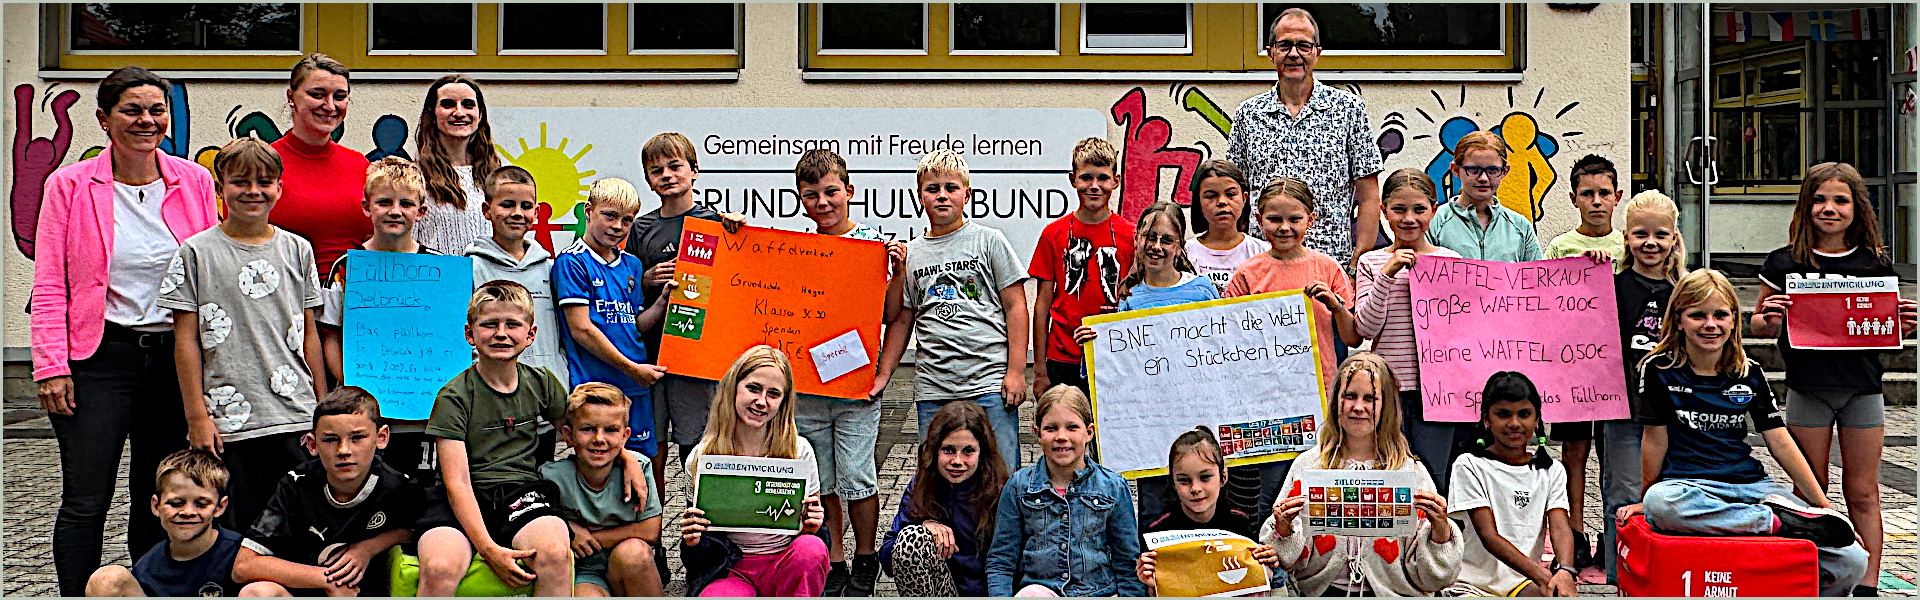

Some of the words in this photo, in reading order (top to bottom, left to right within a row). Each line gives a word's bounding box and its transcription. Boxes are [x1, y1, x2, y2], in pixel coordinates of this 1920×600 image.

[704, 134, 839, 156] Gemeinsam
[848, 133, 883, 155] mit
[889, 133, 965, 156] Freude
[972, 134, 1042, 156] lernen
[348, 254, 441, 282] Füllhorn
[944, 259, 978, 272] STARS
[1411, 259, 1597, 291] WAFFEL-VERKAUF
[1415, 294, 1472, 330] große
[1480, 295, 1551, 314] WAFFEL
[356, 321, 379, 337] Das
[1108, 324, 1156, 353] BNE
[1170, 315, 1227, 340] macht
[1242, 310, 1263, 331] die
[1269, 304, 1305, 327] Welt
[1144, 354, 1170, 376] ein
[1186, 345, 1269, 368] Stückchen
[1274, 336, 1312, 358] besser
[1420, 339, 1473, 364] kleine
[1478, 339, 1553, 363] WAFFEL
[1422, 381, 1455, 407] Wir
[1571, 385, 1621, 404] Füllhorn
[754, 480, 762, 494] 3
[1681, 570, 1692, 597] 1
[1704, 571, 1733, 584] KEINE
[1703, 586, 1739, 597] ARMUT
